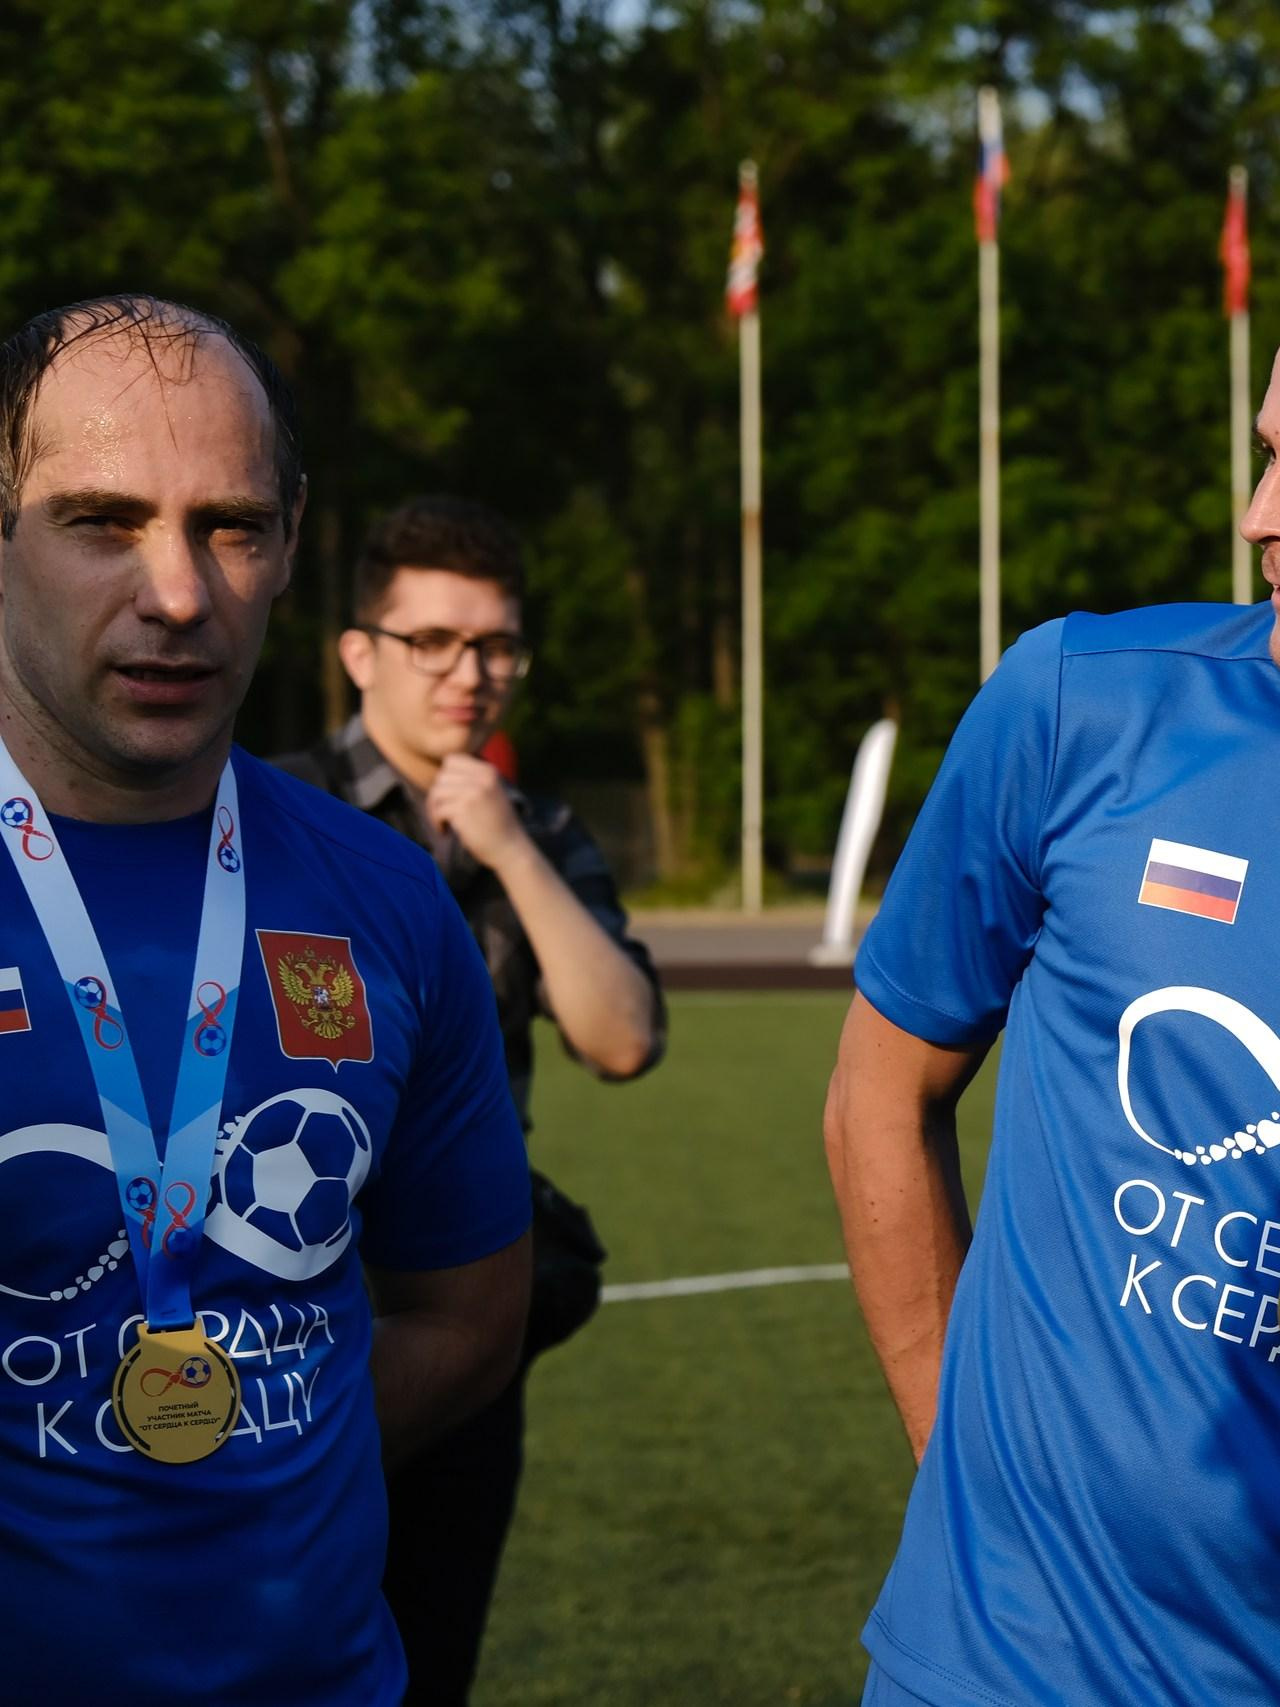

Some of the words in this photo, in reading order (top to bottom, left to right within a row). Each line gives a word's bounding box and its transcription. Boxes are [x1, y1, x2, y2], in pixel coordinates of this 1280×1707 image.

[1113, 1179, 1204, 1248] ОТ
[1119, 1254, 1162, 1315] К
[2, 1323, 97, 1386] ОТ
[118, 1302, 335, 1366] СРДЦА
[37, 1400, 78, 1458] К
[95, 1368, 321, 1453] СДЦУ
[147, 1412, 186, 1422] УЧАСТНИК
[153, 1421, 183, 1430] СЕРДЦА
[158, 1402, 198, 1412] ПОЧЕТНЫЙ
